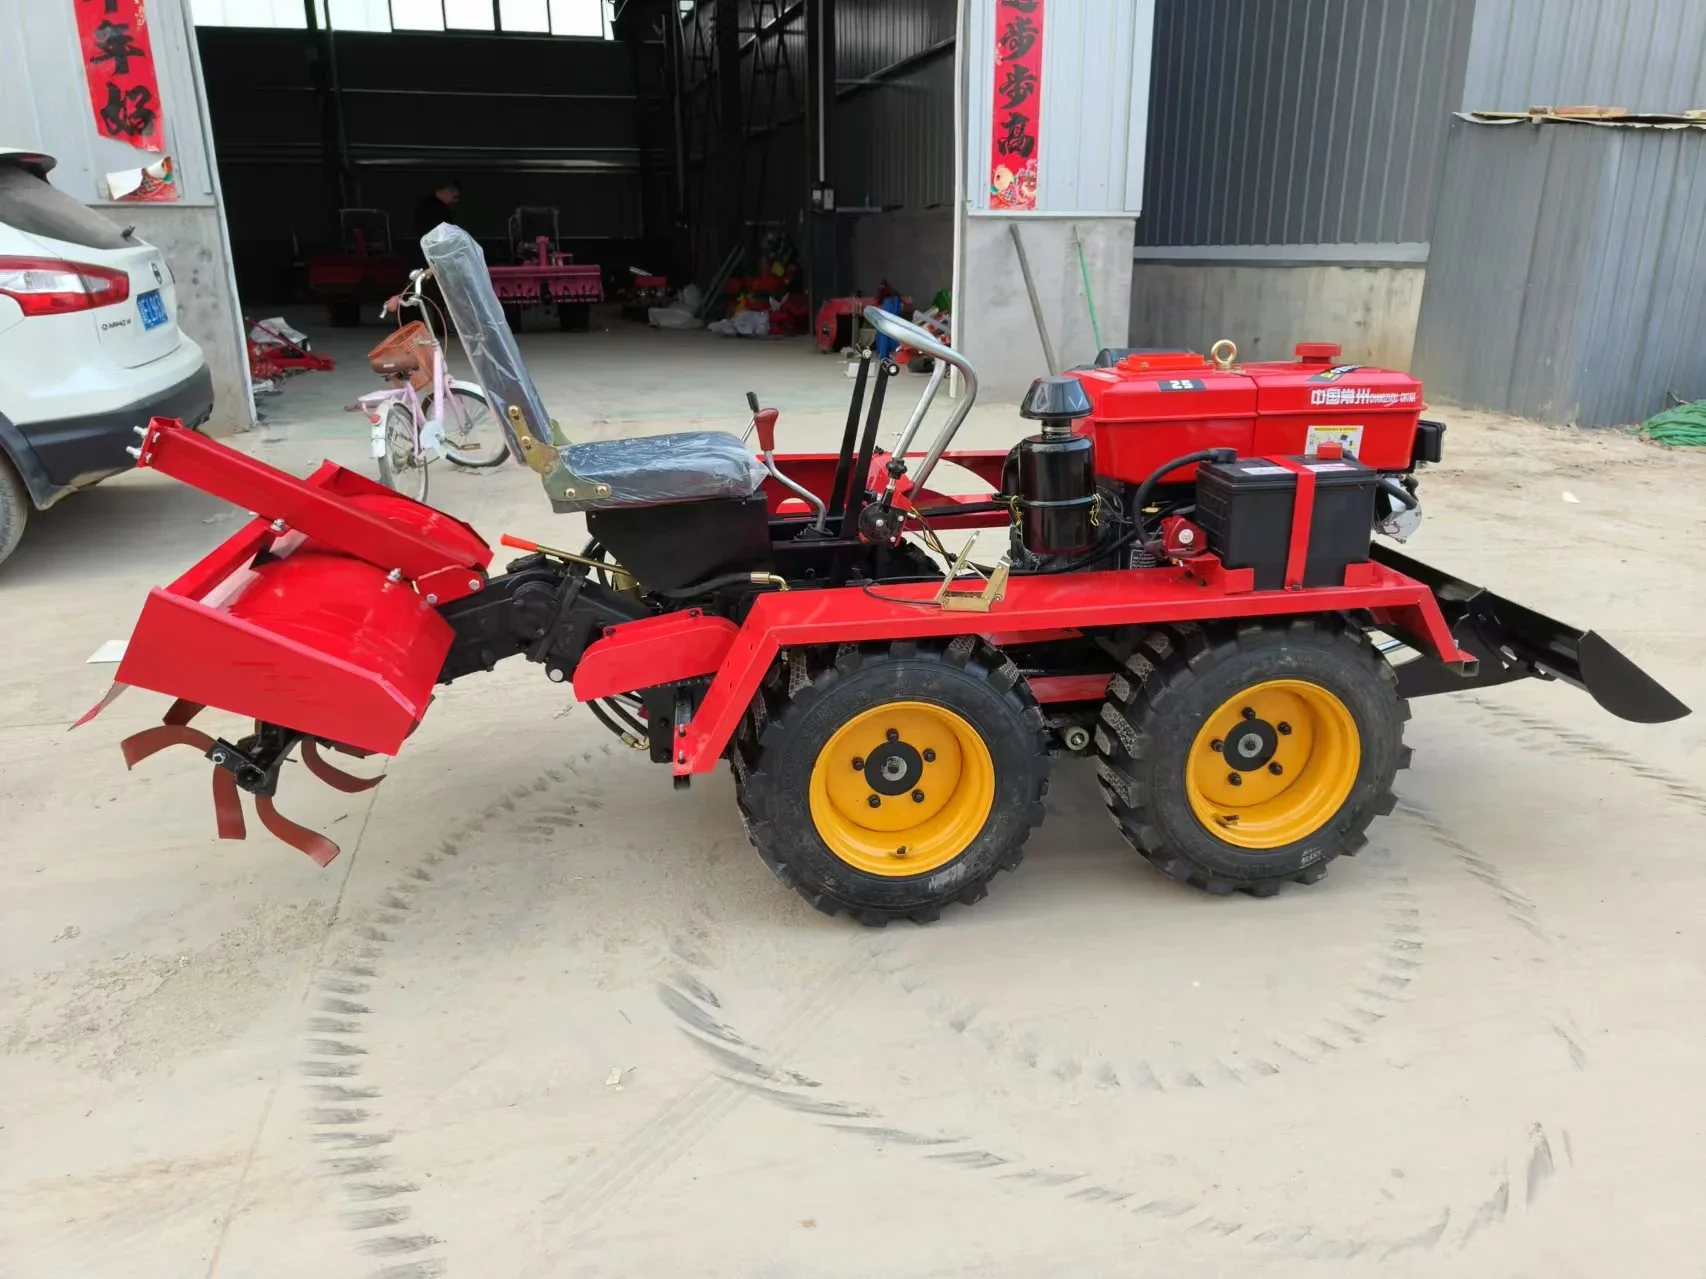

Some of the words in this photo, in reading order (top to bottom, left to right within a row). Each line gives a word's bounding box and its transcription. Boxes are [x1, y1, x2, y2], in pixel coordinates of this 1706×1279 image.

[86, 0, 156, 136] 年好
[1169, 379, 1194, 389] 25
[1310, 387, 1370, 405] 中国常州
